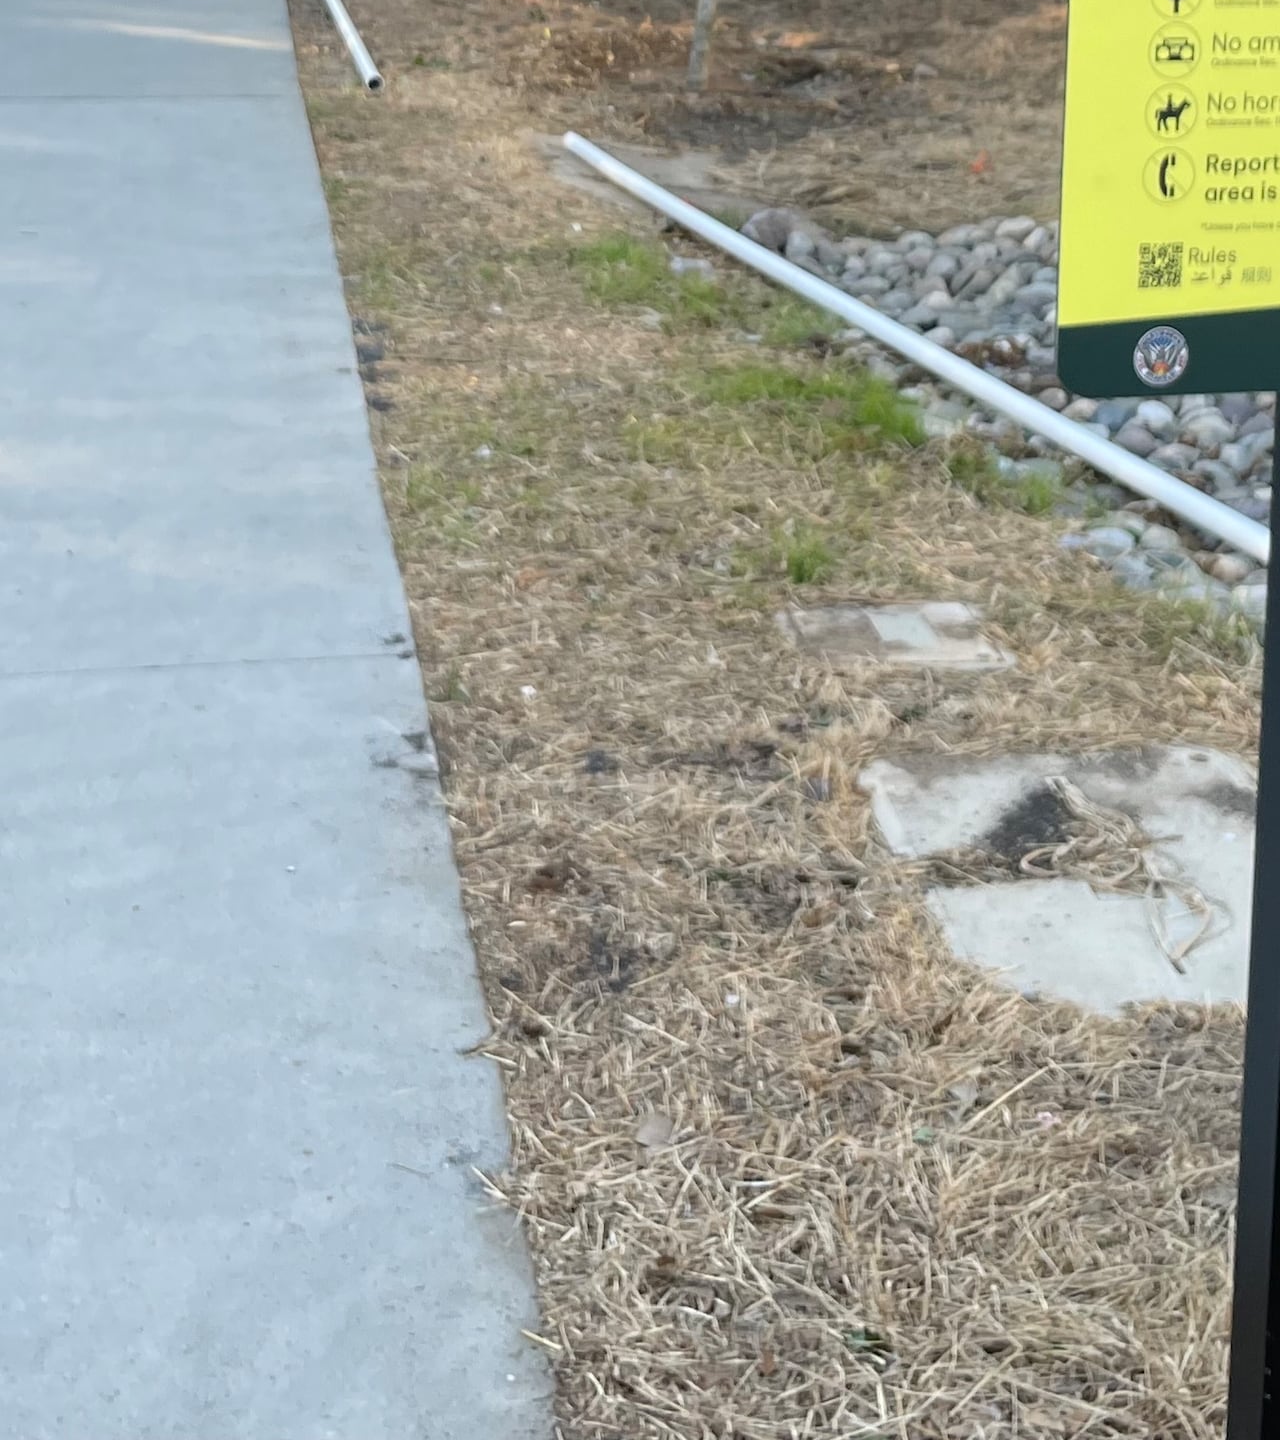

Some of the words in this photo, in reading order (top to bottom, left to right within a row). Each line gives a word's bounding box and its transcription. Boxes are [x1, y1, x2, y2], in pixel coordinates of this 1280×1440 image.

[1212, 32, 1242, 53] No
[1207, 91, 1237, 113] No
[1205, 153, 1280, 178] Report
[1204, 182, 1254, 203] area
[1260, 180, 1278, 201] is
[1188, 245, 1237, 266] Rules
